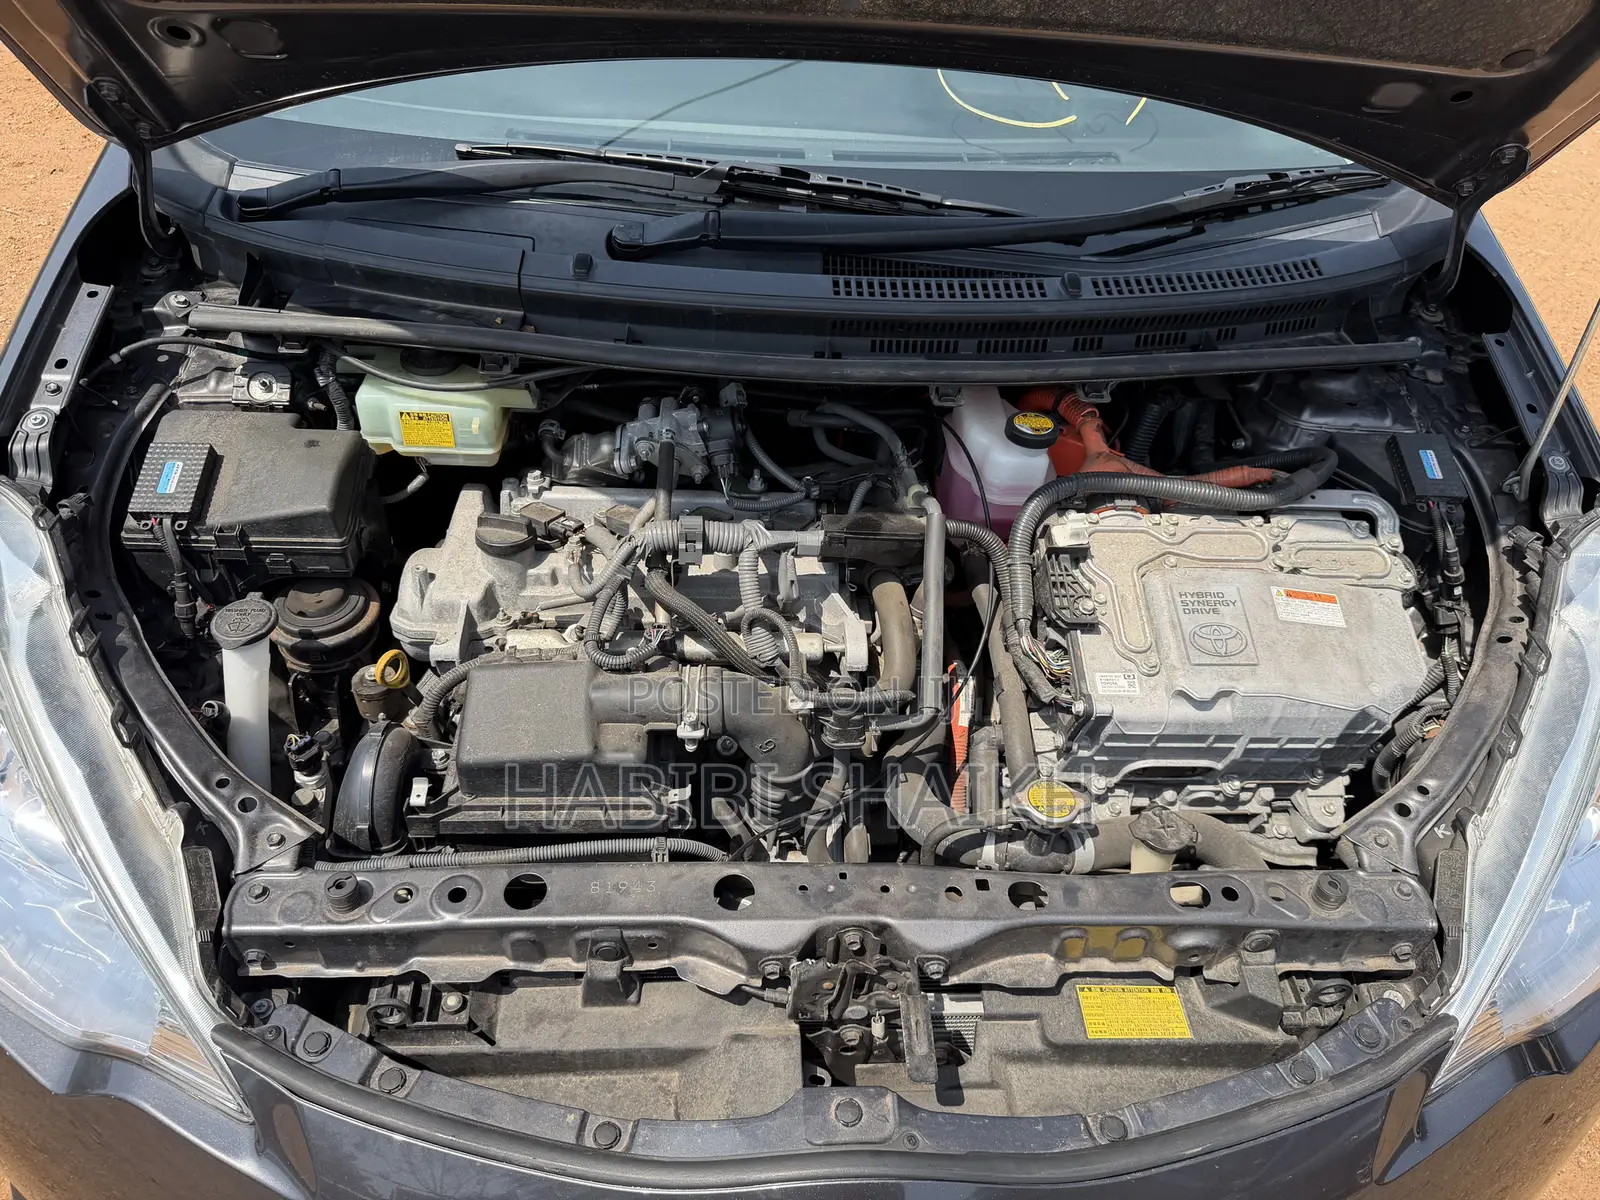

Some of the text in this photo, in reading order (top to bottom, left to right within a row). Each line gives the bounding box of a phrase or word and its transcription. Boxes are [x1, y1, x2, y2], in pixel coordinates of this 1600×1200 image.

[1179, 591, 1225, 599] HYBRID
[1180, 599, 1237, 607] SYNERGY
[1182, 607, 1220, 615] DRIVE
[590, 880, 656, 894] 81943
